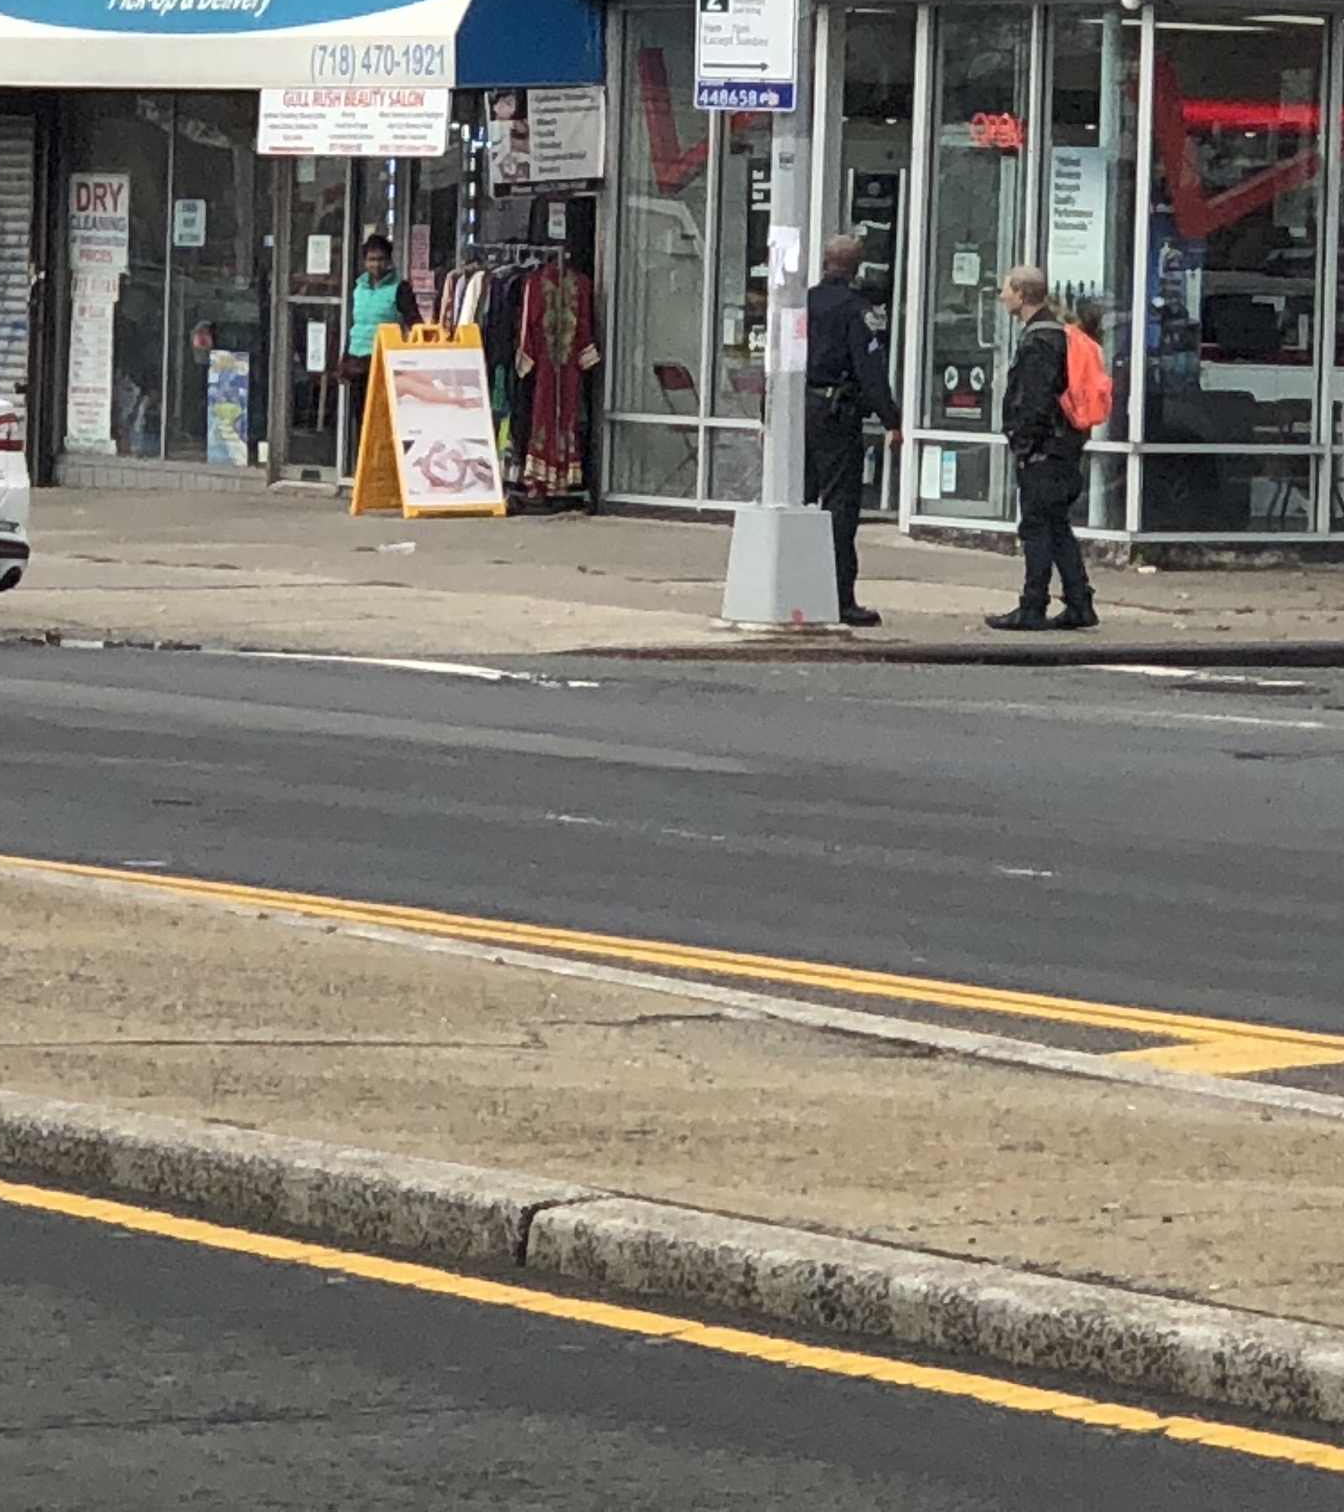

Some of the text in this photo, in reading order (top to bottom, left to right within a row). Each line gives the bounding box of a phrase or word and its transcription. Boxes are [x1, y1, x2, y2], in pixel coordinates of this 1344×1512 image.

[311, 45, 357, 83] (718)
[360, 43, 446, 77] 470-1921
[344, 89, 386, 107] BEAUTY
[389, 89, 425, 107] SALON
[76, 181, 124, 213] DRY
